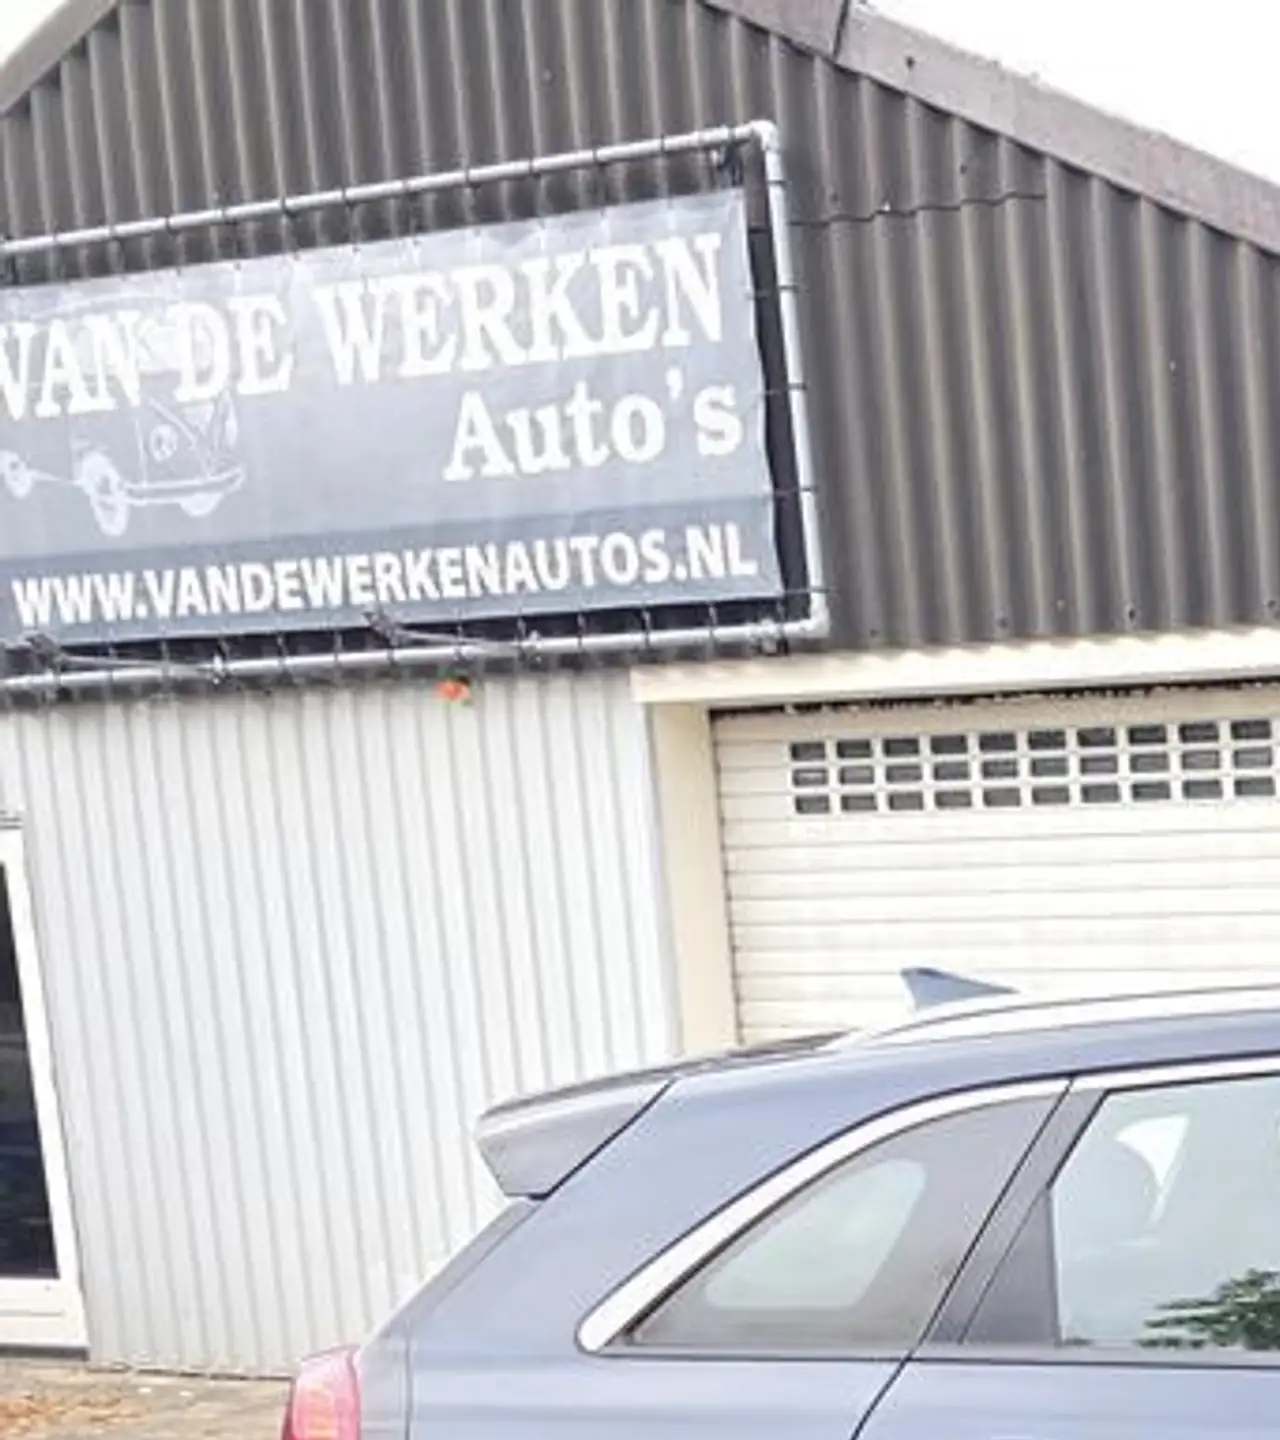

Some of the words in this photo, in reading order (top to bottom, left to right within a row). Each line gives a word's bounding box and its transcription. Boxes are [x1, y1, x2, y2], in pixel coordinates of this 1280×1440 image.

[0, 308, 141, 421] VAN
[165, 295, 294, 402] DE
[312, 232, 722, 387] WERKEN
[442, 364, 743, 481] Auto's
[11, 522, 758, 628] WWW.VANDEWERKENAUTOS.NL
